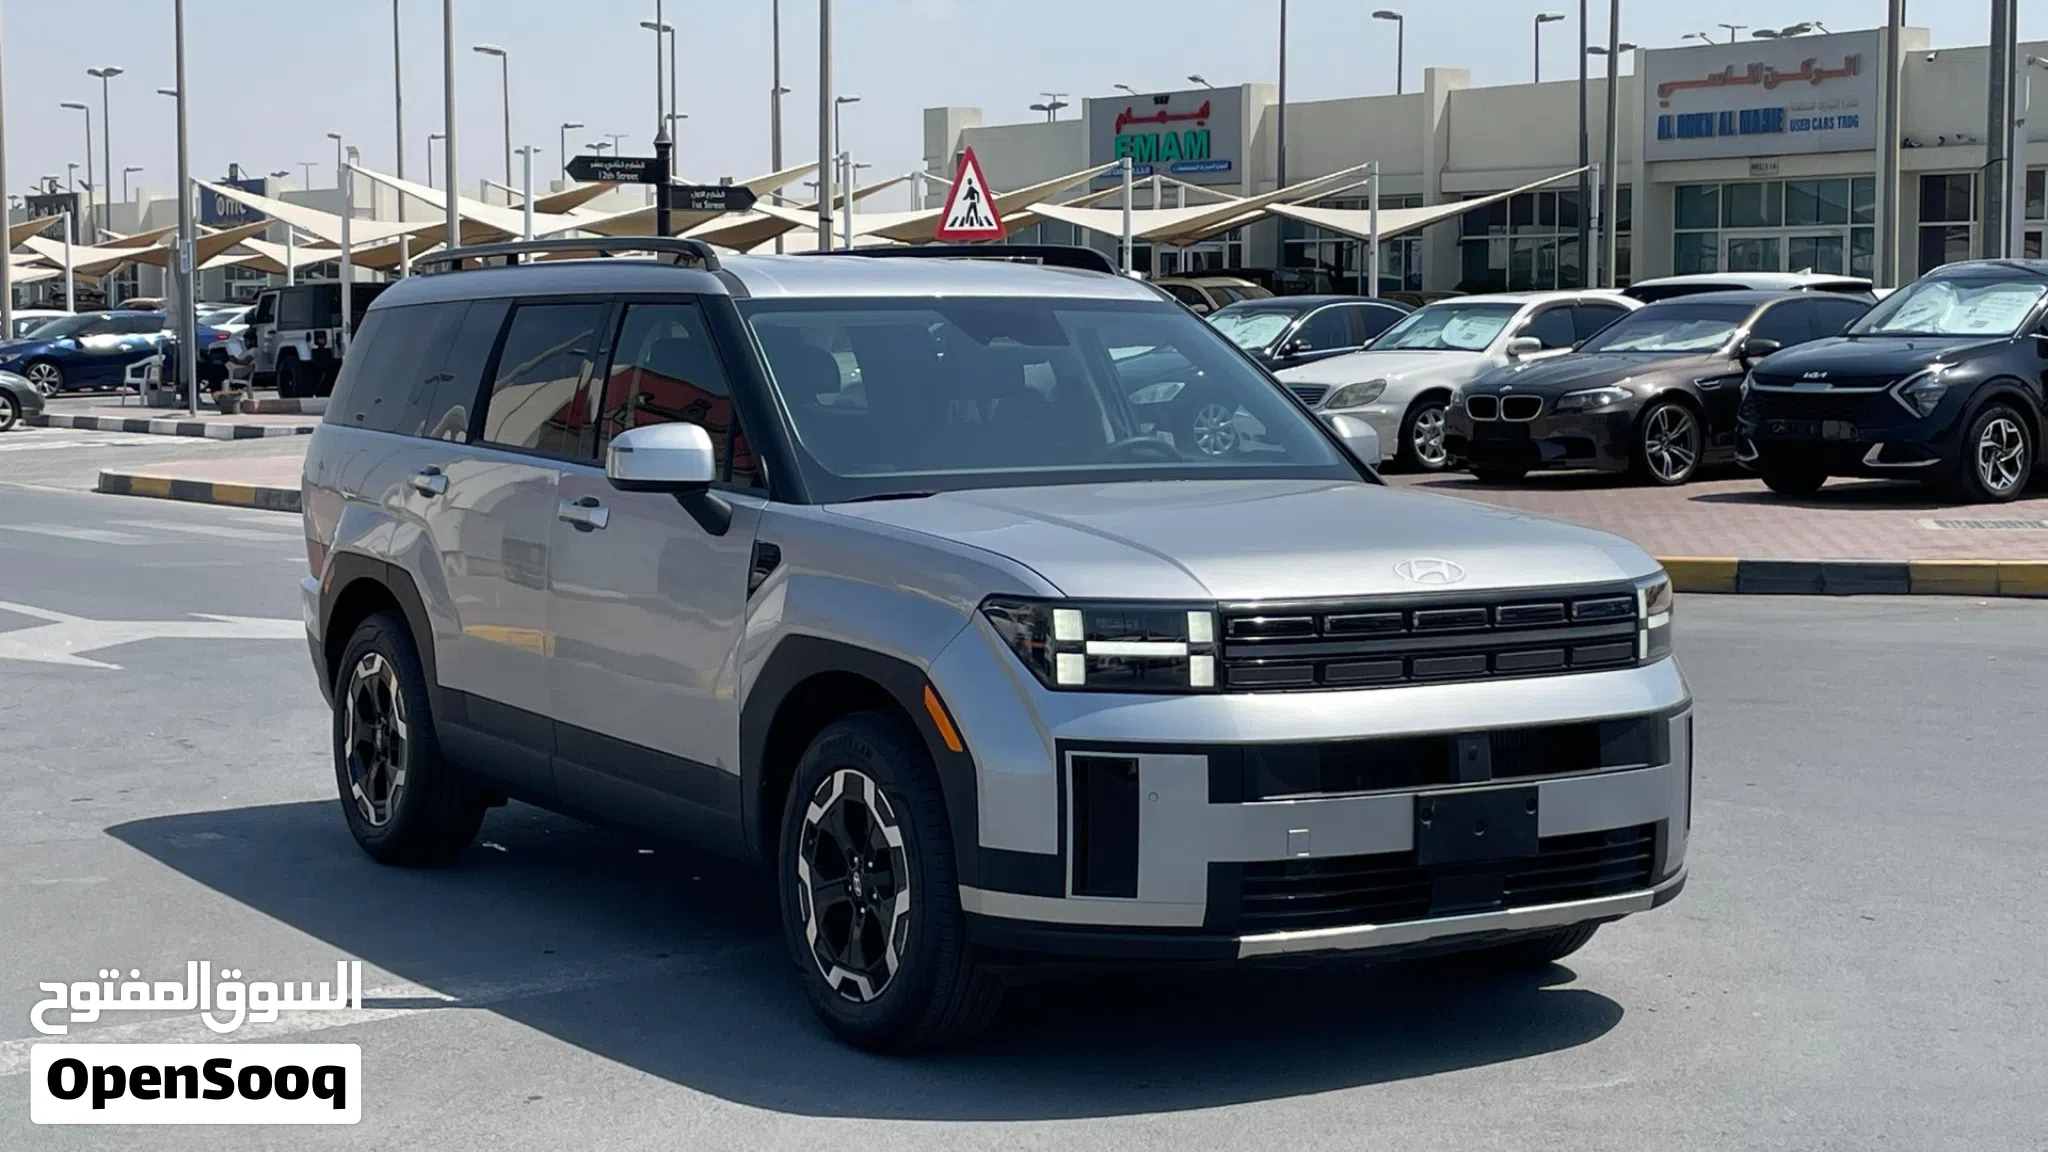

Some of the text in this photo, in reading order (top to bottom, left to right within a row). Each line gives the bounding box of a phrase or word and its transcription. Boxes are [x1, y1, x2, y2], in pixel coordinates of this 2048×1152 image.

[1657, 114, 1674, 140] AL
[1719, 110, 1736, 136] AL
[1790, 118, 1811, 132] USED
[1812, 116, 1835, 130] CARS
[1837, 114, 1859, 129] TRDG
[1114, 128, 1211, 162] EMAM
[598, 170, 639, 181] 12th Street
[691, 200, 726, 209] 1st Street
